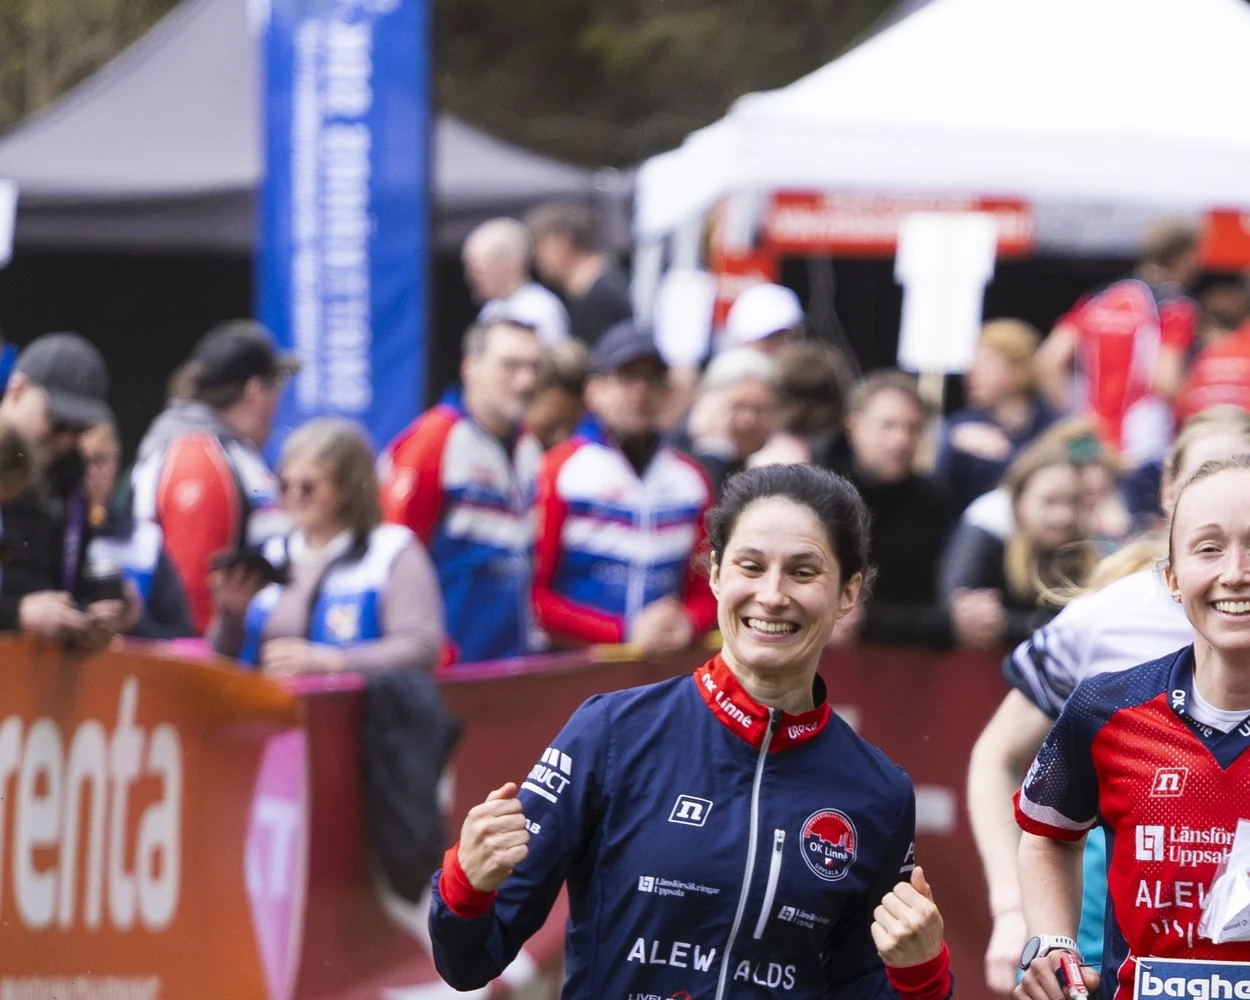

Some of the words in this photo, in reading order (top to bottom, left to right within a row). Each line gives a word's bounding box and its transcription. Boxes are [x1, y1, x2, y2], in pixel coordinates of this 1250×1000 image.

[715, 690, 752, 728] Linné
[1172, 689, 1186, 709] OK
[810, 842, 822, 854] OK
[824, 846, 849, 862] Linné
[654, 877, 720, 895] Länsförsäkringar
[654, 885, 685, 897] Uppsala
[627, 937, 716, 972] ALEW
[734, 959, 796, 990] ALDS
